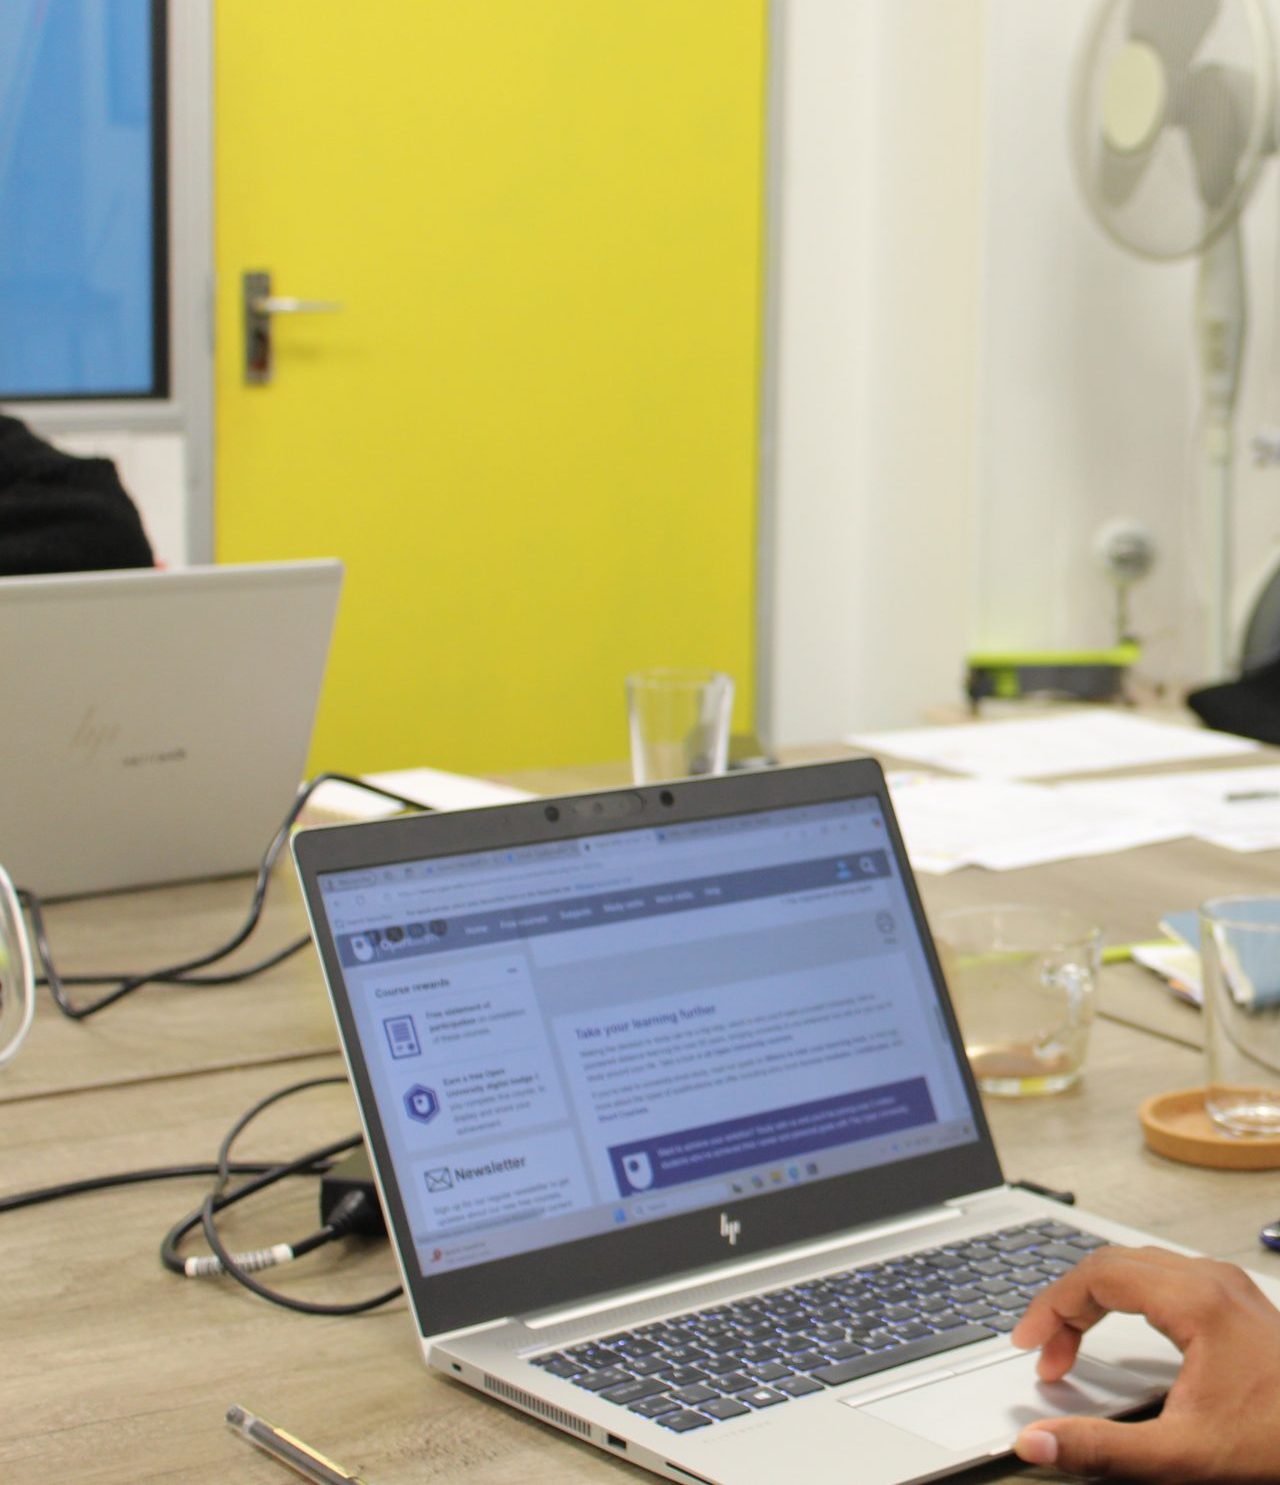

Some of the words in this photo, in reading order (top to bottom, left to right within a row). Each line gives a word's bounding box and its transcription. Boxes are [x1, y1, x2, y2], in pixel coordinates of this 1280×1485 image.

[375, 985, 411, 999] Course
[412, 977, 450, 991] rewards
[444, 1003, 479, 1016] statement
[429, 1016, 477, 1033] participation
[575, 1027, 602, 1039] Take
[603, 1020, 630, 1037] your
[631, 1011, 679, 1029] learning
[678, 1004, 716, 1020] further
[442, 1076, 461, 1087] Earn
[468, 1071, 485, 1081] free
[484, 1067, 506, 1078] Open
[446, 1083, 485, 1099] University
[485, 1079, 509, 1091] digital
[510, 1074, 534, 1085] badge
[454, 1156, 525, 1181] Newsletter
[720, 1211, 742, 1247] hp
